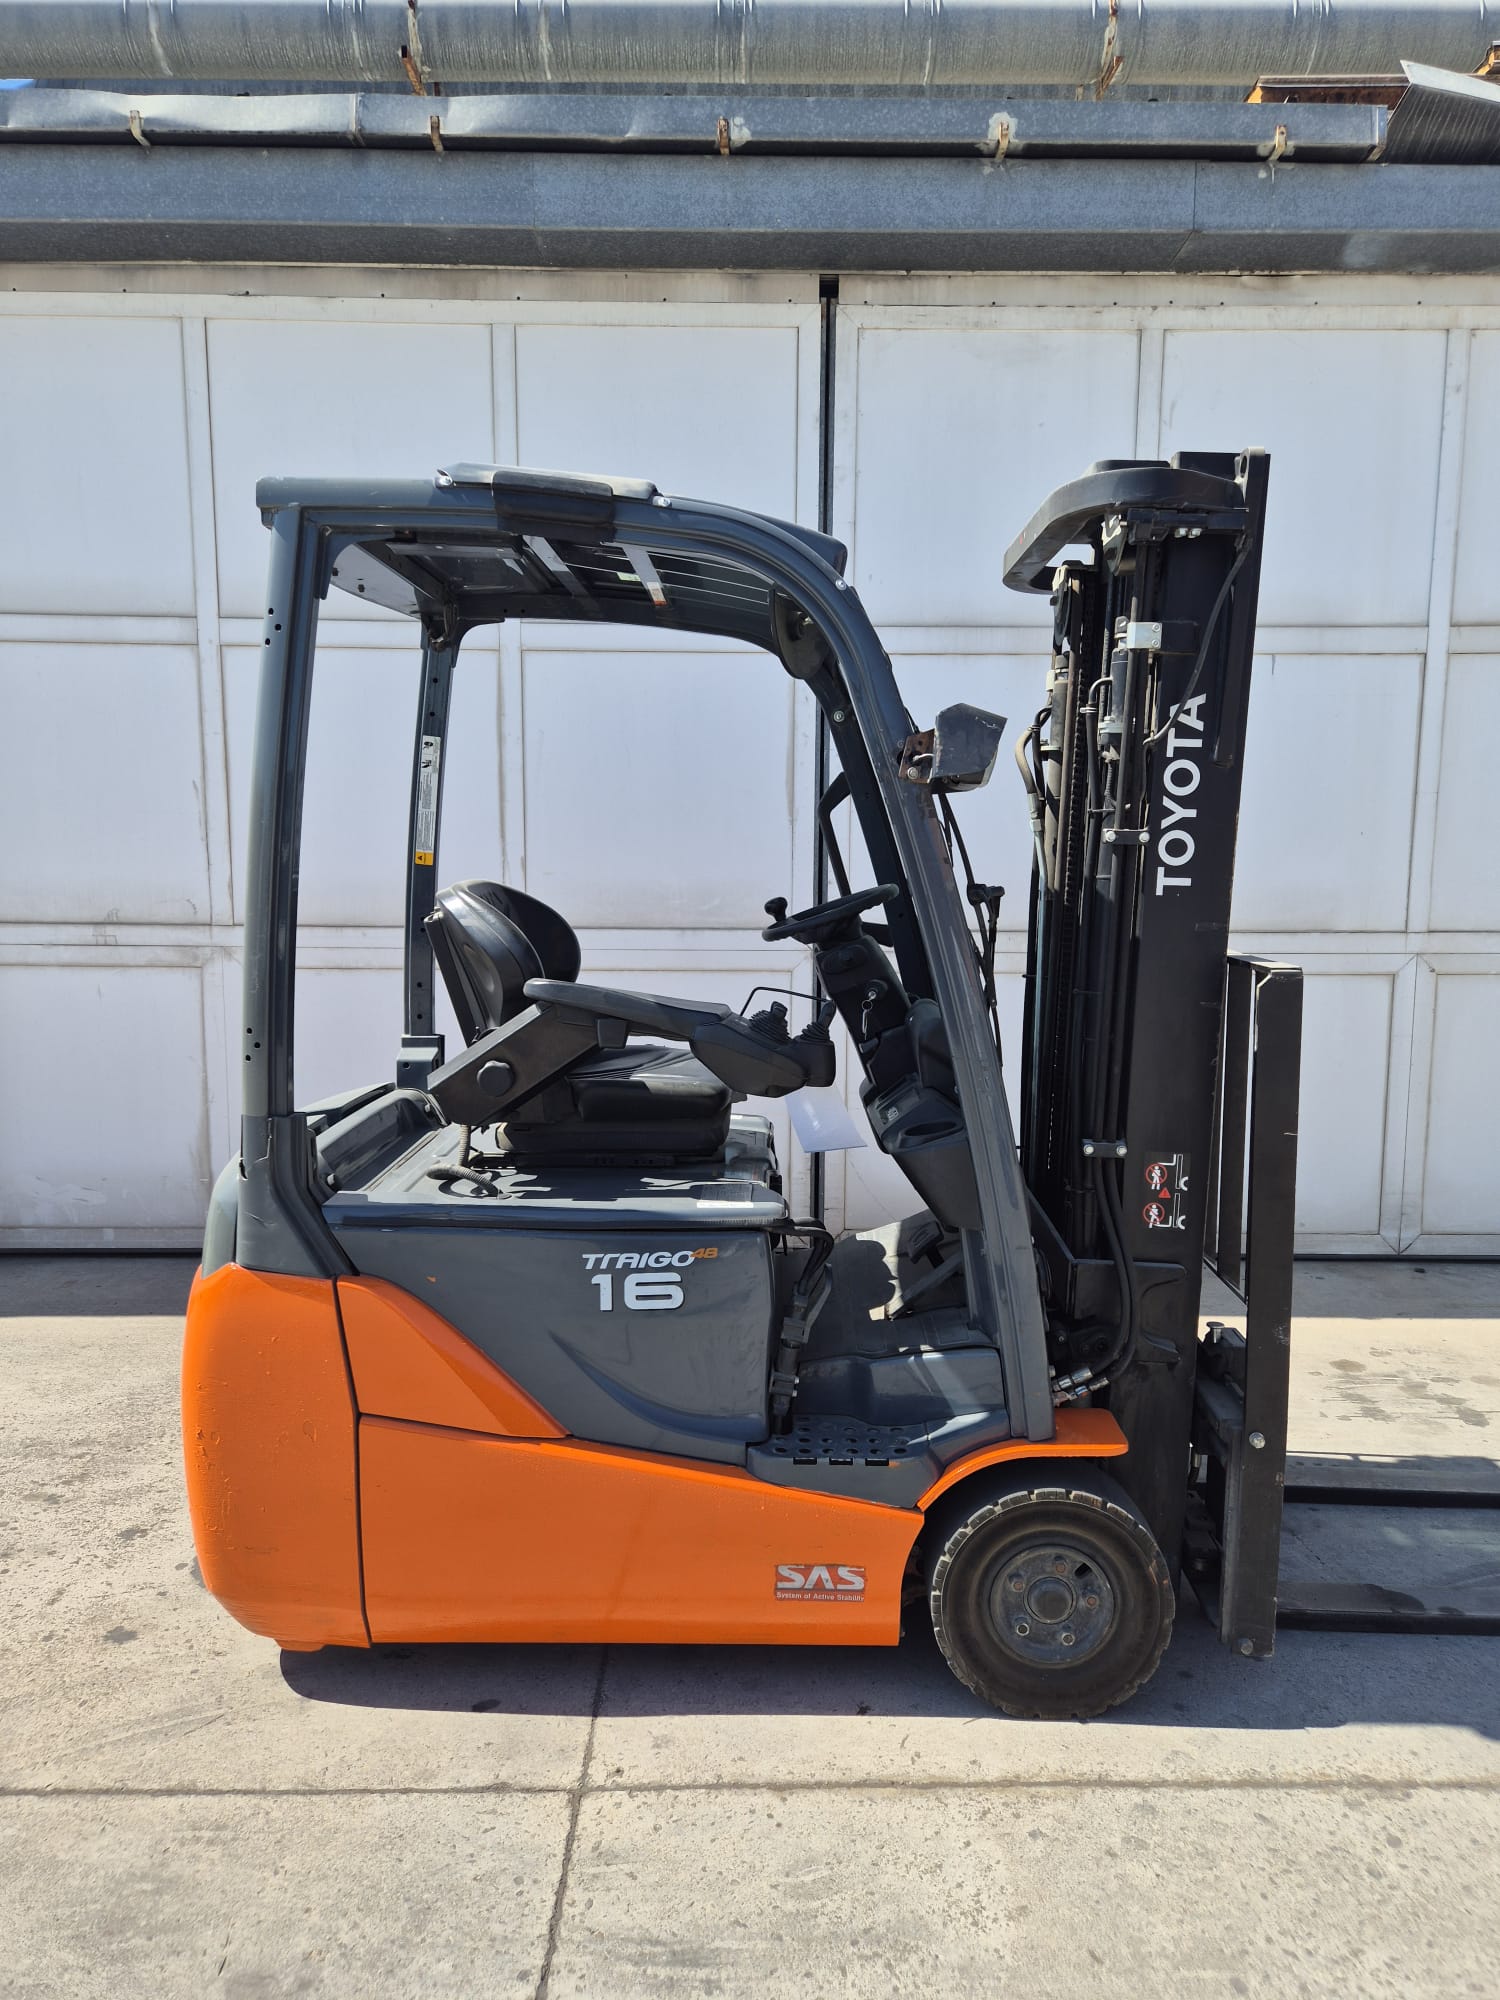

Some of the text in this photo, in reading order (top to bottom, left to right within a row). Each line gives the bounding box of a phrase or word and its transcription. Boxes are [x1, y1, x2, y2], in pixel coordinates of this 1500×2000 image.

[1155, 692, 1207, 896] TOYOTA
[591, 1271, 685, 1312] 16
[777, 1565, 865, 1591] SAS
[776, 1591, 802, 1601] System
[813, 1593, 835, 1601] Active
[837, 1594, 865, 1603] Stability
